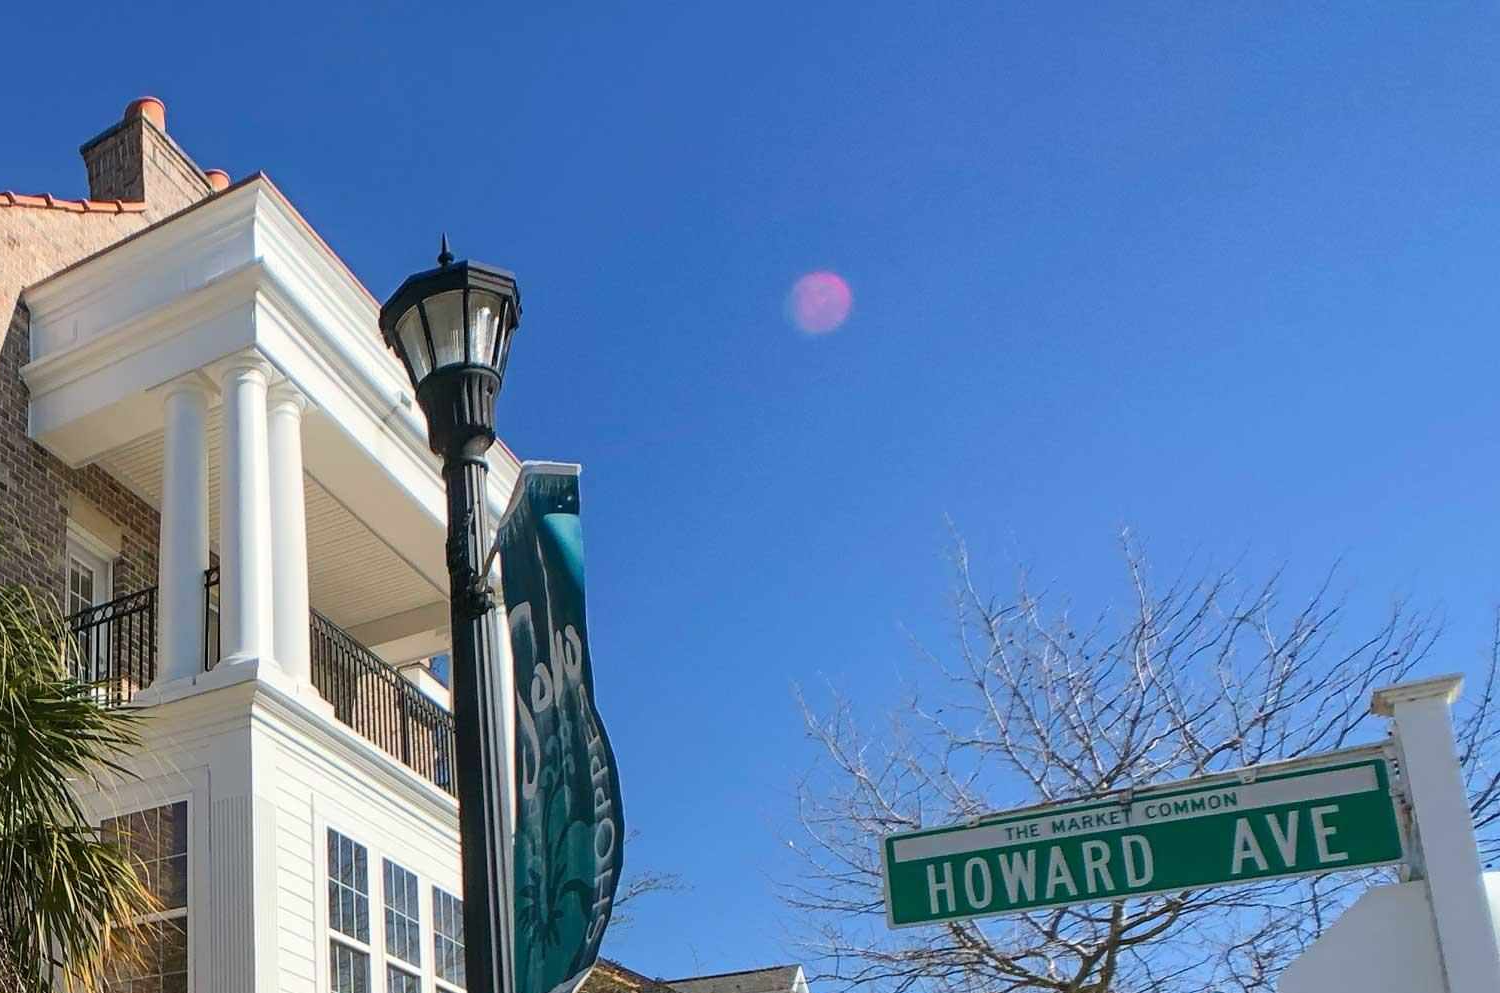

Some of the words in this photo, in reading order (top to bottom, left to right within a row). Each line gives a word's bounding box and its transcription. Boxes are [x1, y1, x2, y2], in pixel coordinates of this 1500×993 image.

[1004, 823, 1041, 841] THE
[1051, 807, 1132, 834] MARKET
[1144, 791, 1237, 819] COMMON
[926, 834, 1155, 914] HOWARD
[1230, 804, 1349, 875] AVE
